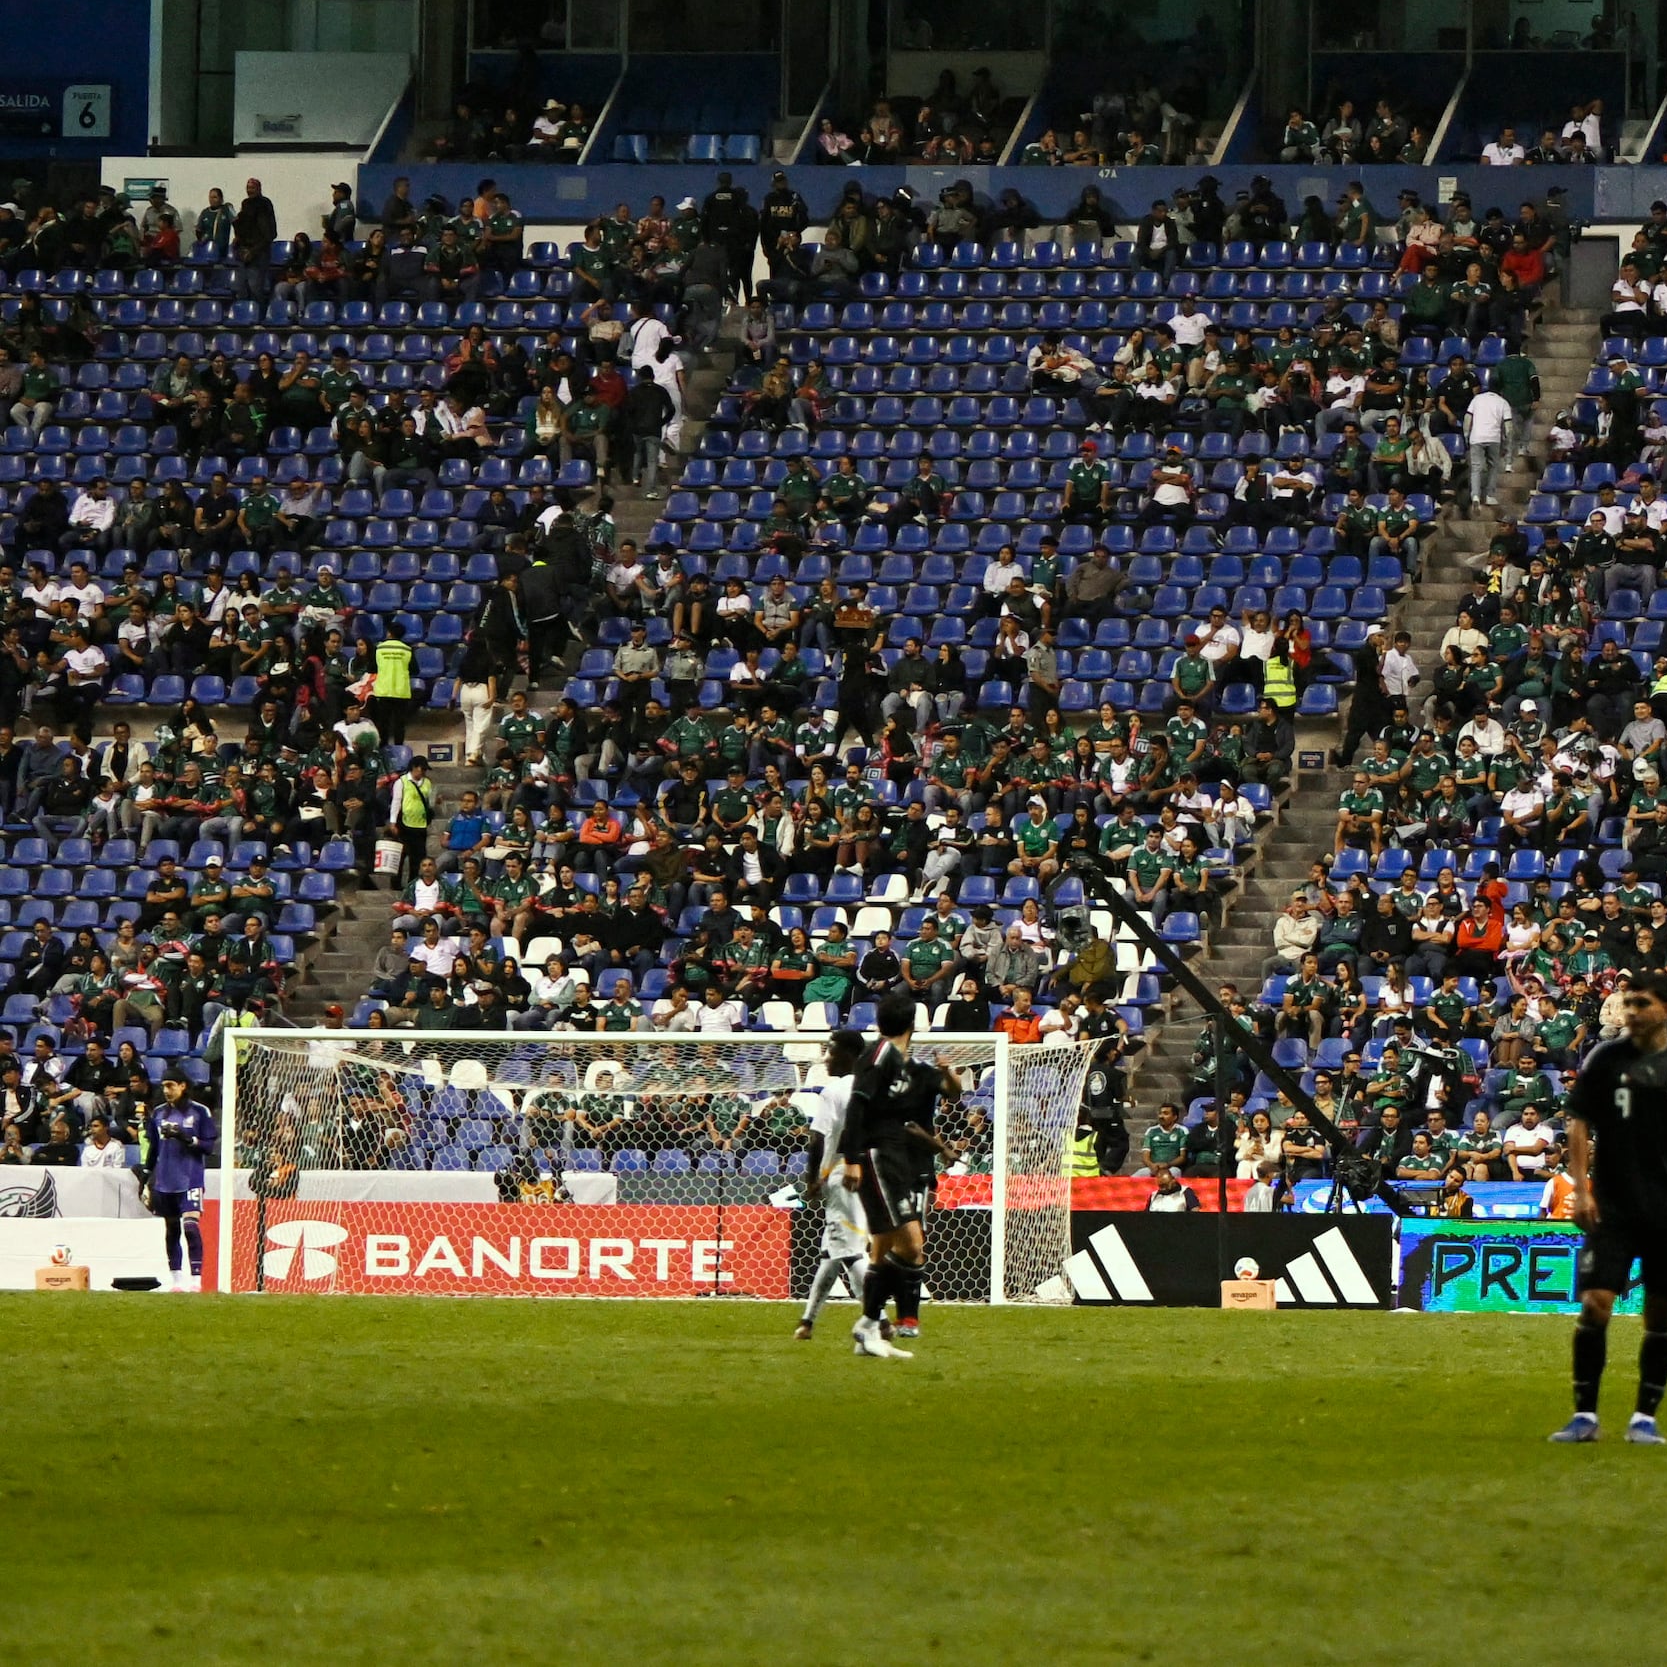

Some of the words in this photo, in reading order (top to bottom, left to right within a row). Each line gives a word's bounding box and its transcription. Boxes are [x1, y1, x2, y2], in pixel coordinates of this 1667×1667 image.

[0, 94, 50, 108] SALIDA
[79, 102, 96, 128] 6
[1098, 168, 1118, 179] 47A
[1614, 1087, 1631, 1119] 9
[365, 1234, 735, 1283] BANORTE
